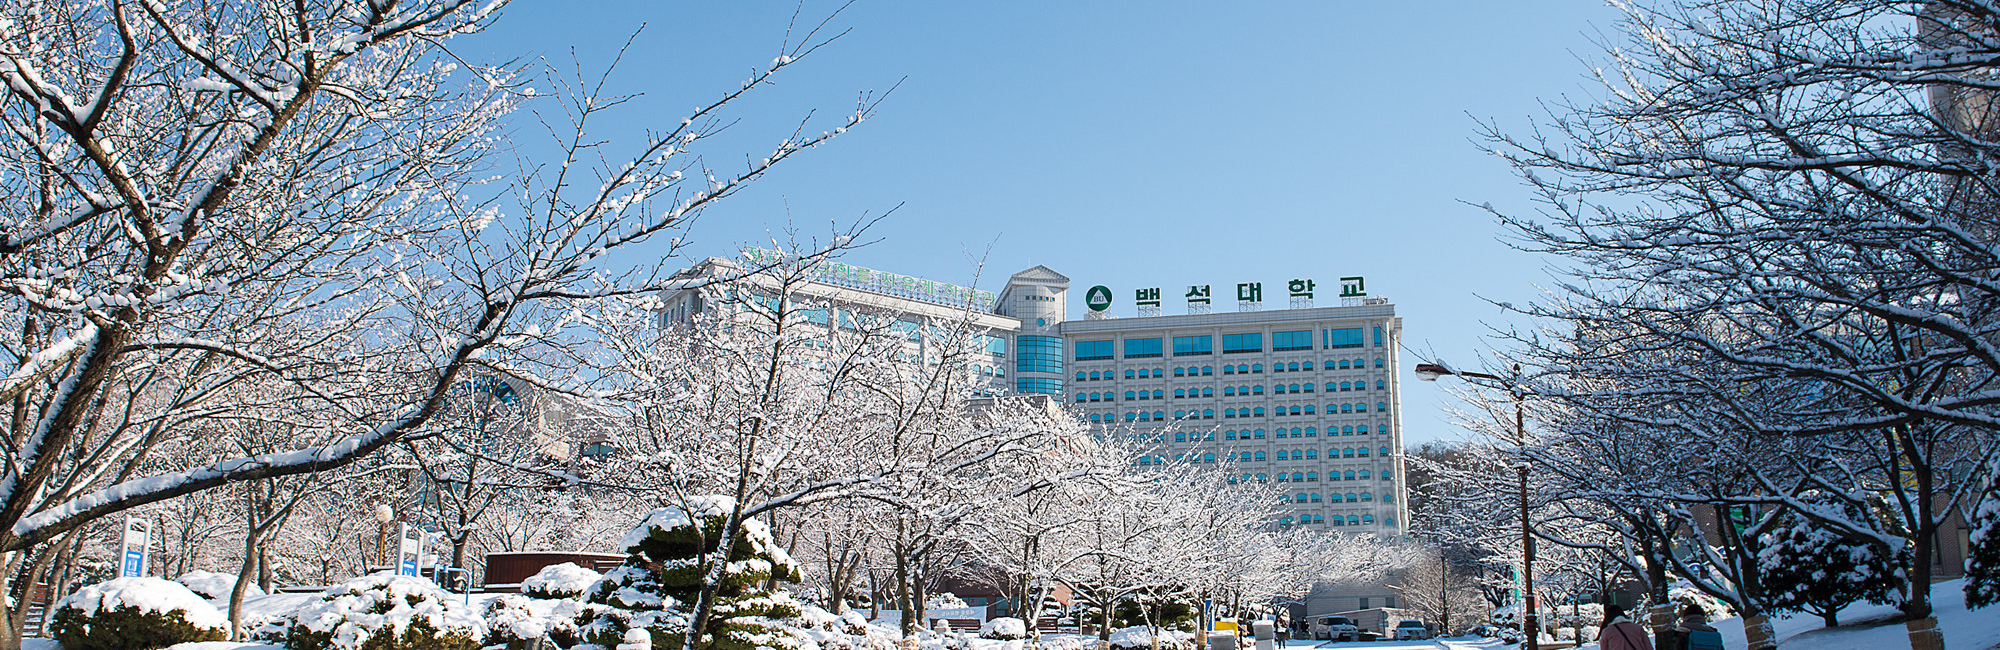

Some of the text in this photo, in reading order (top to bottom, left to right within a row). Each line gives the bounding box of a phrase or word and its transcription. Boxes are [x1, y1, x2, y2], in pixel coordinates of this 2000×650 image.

[881, 272, 934, 295] 자유케
[1135, 276, 1367, 307] 백석대학교
[1093, 295, 1105, 303] BU
